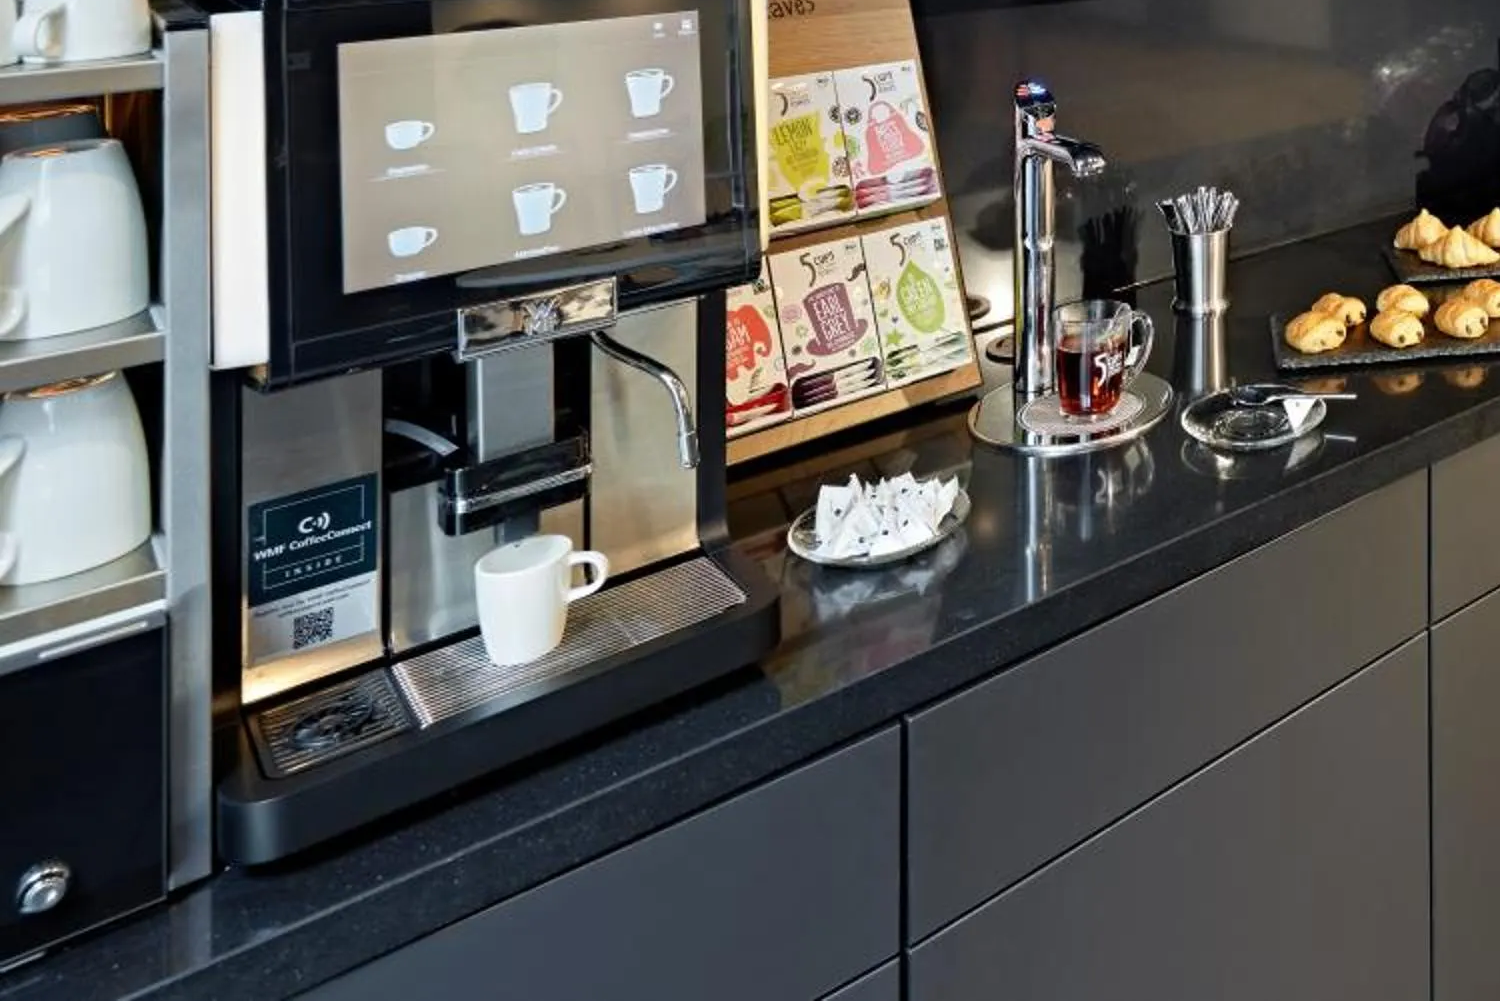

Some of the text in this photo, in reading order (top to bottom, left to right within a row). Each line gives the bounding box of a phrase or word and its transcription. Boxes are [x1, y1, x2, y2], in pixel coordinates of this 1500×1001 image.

[889, 232, 906, 267] 5
[799, 252, 817, 287] 5
[253, 544, 287, 562] WMF
